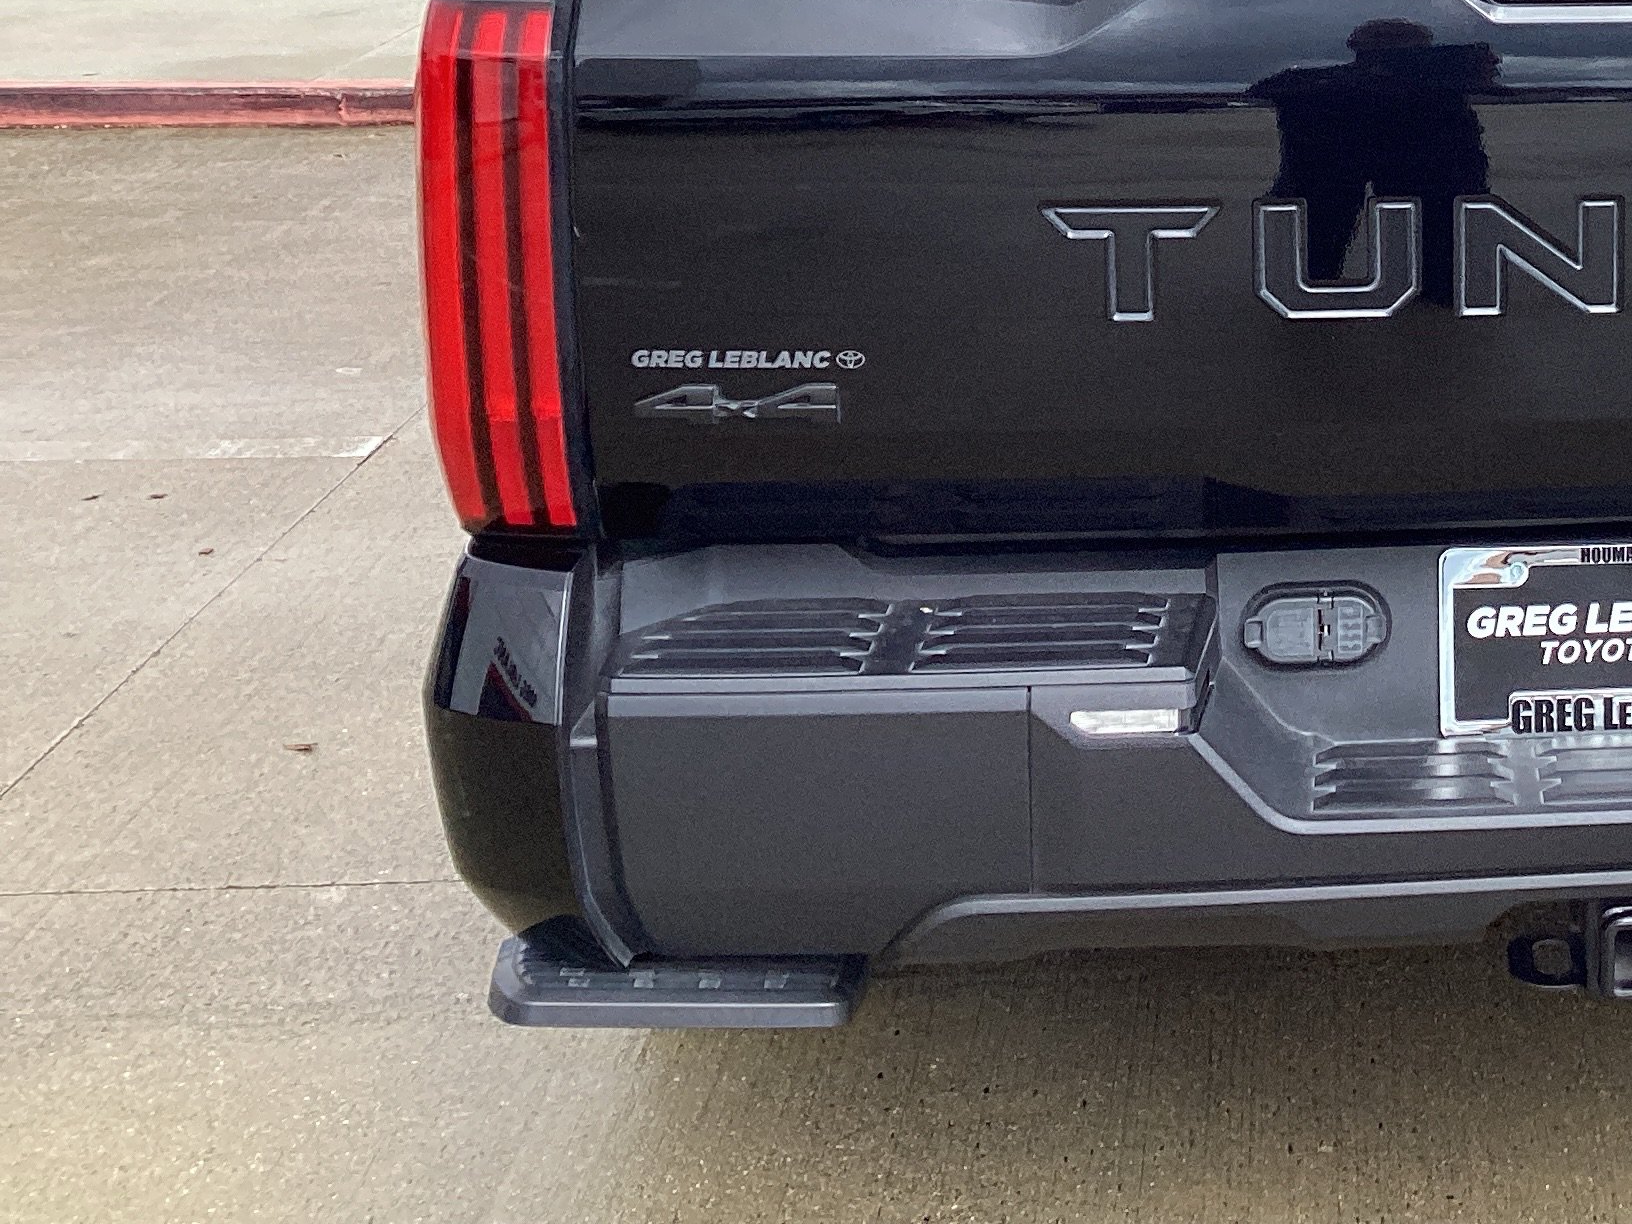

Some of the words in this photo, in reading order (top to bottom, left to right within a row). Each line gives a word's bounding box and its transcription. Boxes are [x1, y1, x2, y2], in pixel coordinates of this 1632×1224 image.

[630, 349, 705, 369] GREG
[707, 349, 832, 369] LEBLANC
[1467, 601, 1578, 639] GREG
[1511, 697, 1594, 734] GREG
